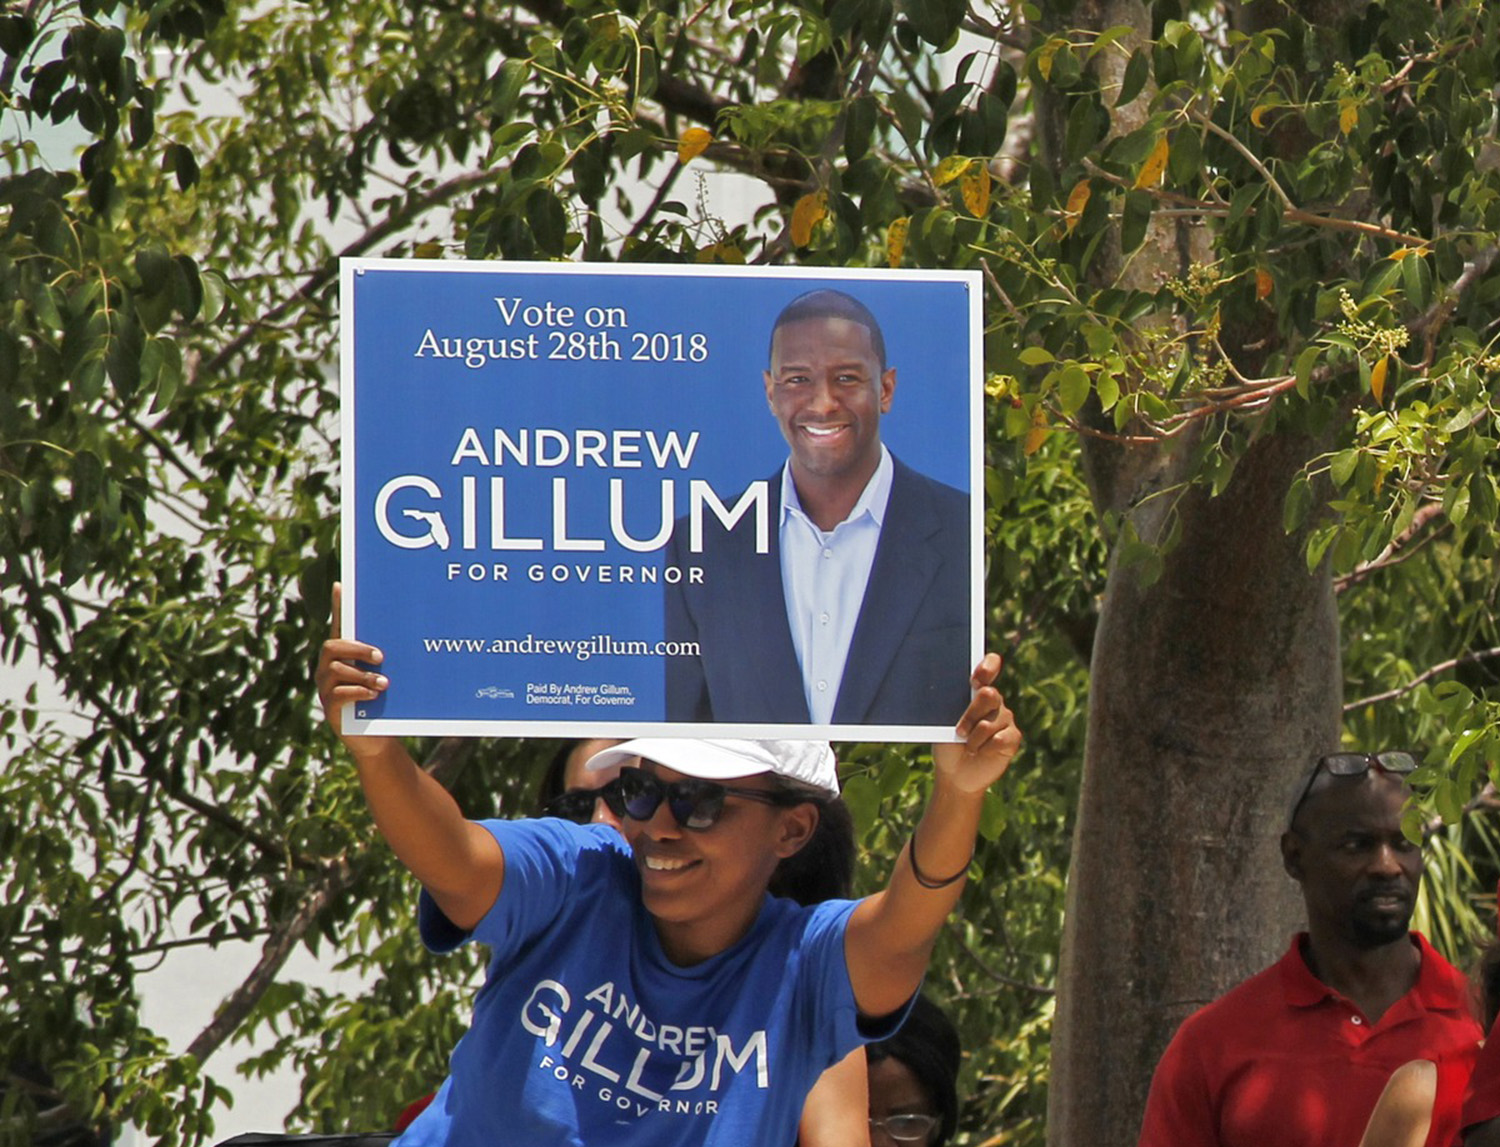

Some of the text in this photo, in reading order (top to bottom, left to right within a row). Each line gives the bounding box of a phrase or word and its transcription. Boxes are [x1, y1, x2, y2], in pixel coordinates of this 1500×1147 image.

[494, 297, 629, 328] Vote on
[414, 328, 708, 368] August 28th 2018
[451, 427, 700, 469] ANDREW
[374, 474, 770, 554] GILLUM
[447, 563, 705, 584] FOR GOVERNOR
[423, 634, 701, 661] www.andrewgillum.com
[526, 683, 547, 694] Paid
[549, 684, 563, 696] By
[563, 684, 598, 694] Andrew
[600, 684, 632, 696] Gillum,
[526, 694, 636, 706] Democrat, For Governor
[585, 981, 718, 1056] ANDRE
[539, 1055, 719, 1118] FOR GOVRNOR
